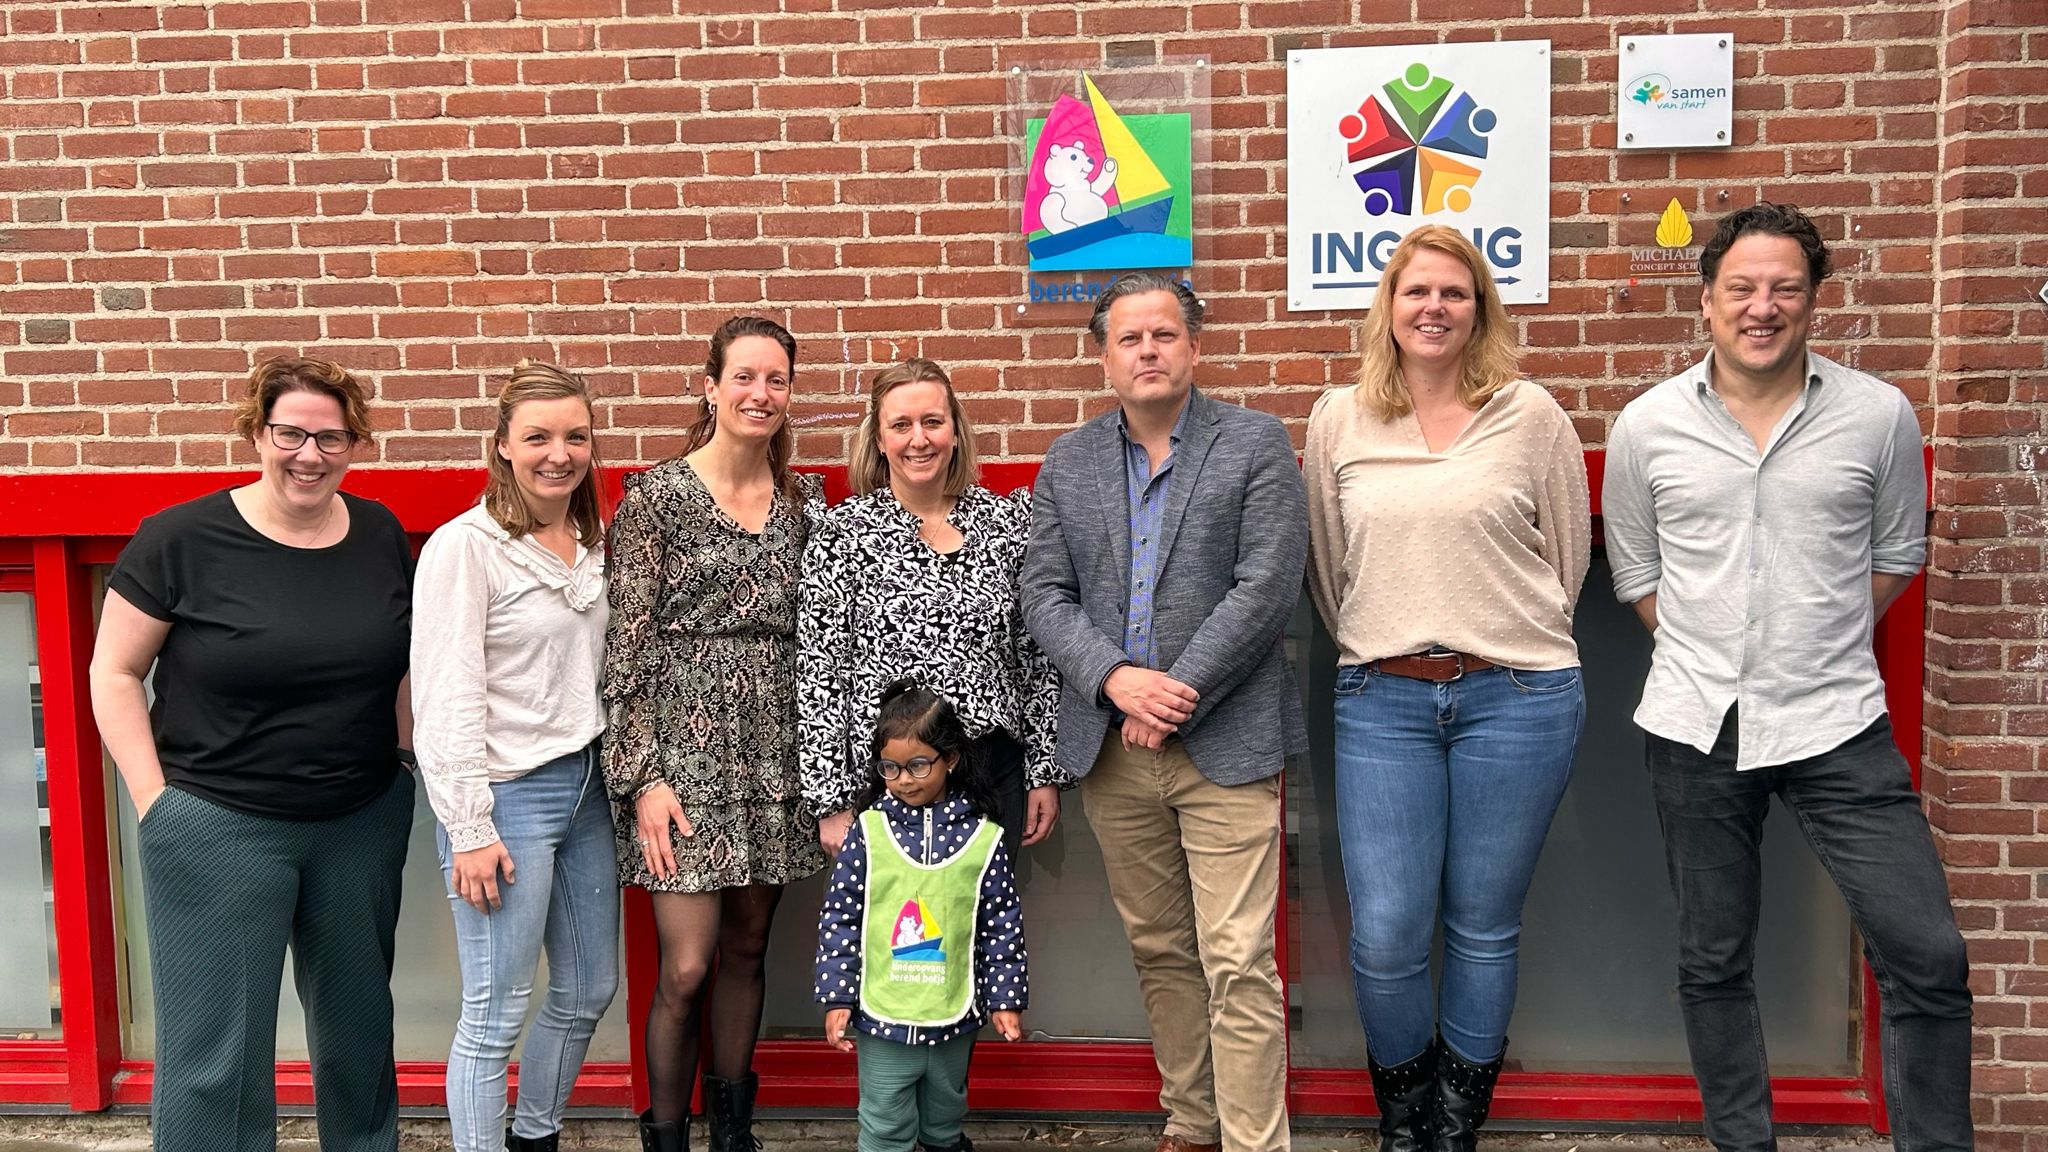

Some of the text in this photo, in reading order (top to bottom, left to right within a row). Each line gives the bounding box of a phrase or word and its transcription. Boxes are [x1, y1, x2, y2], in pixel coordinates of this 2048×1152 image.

[1671, 87, 1726, 99] samen
[1657, 99, 1706, 110] van start
[1312, 226, 1522, 274] INGG
[1630, 262, 1697, 271] CONCEPT SCH
[890, 971, 946, 985] berend botje
